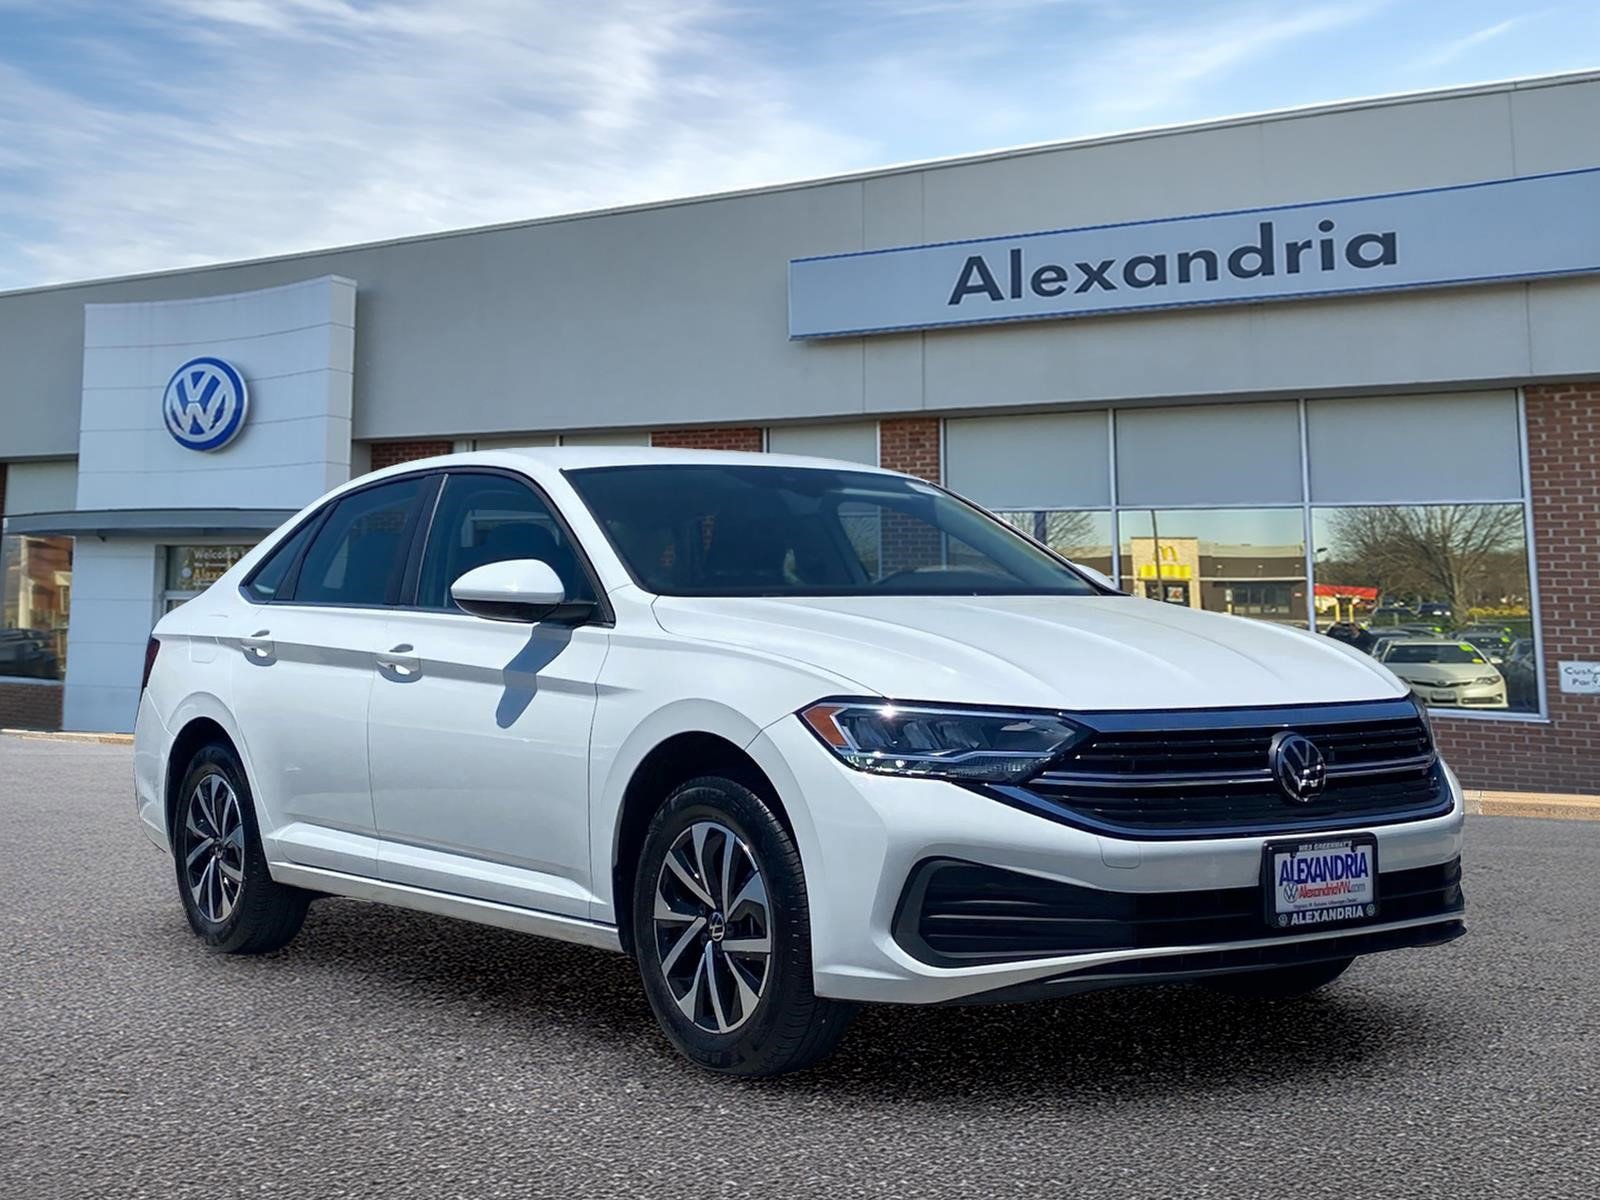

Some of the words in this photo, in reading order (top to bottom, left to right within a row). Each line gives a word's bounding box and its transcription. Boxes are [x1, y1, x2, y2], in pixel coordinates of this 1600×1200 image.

[948, 219, 1397, 305] Alexandria
[164, 358, 243, 448] VW
[1279, 852, 1369, 887] ALEXANDRIA
[1291, 905, 1364, 926] ALEXANDRIA
